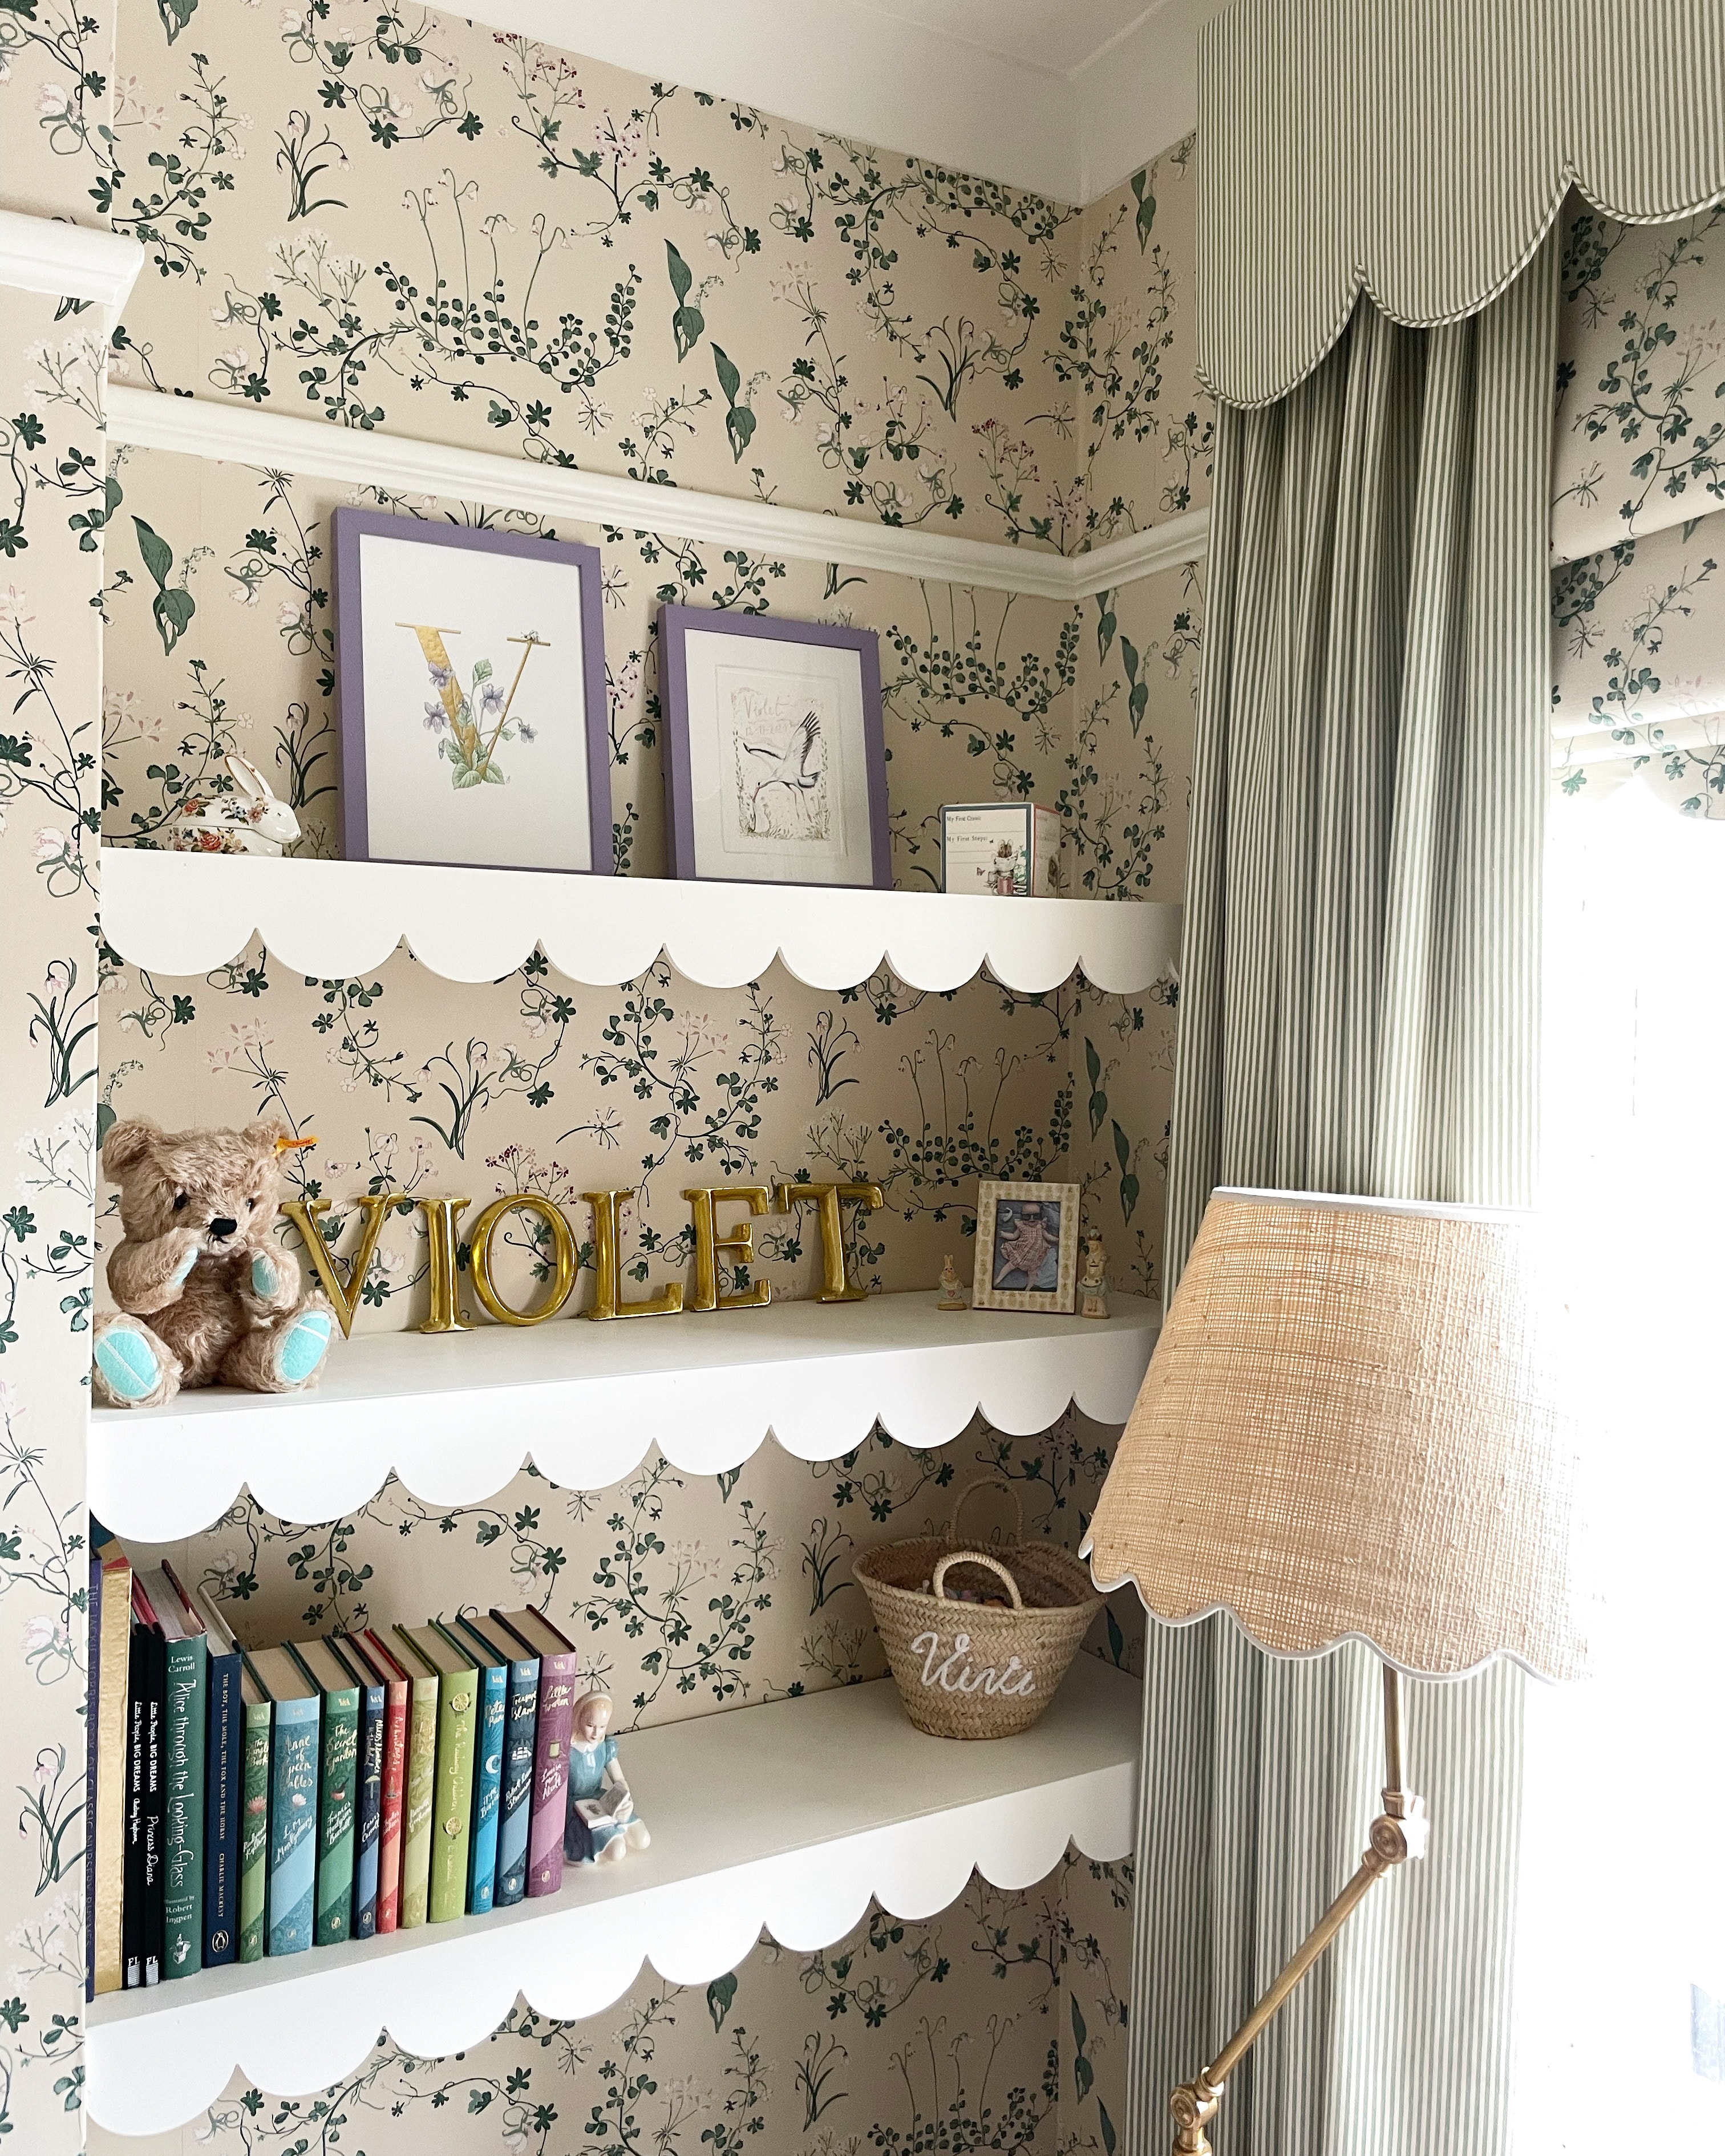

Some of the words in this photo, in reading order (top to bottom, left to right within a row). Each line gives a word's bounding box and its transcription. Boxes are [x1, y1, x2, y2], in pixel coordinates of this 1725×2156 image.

[280, 1182, 884, 1340] VIOLET
[168, 1662, 195, 1672] Carroll
[171, 1655, 193, 1664] Lewis
[168, 1679, 197, 1713] Alice
[543, 1684, 572, 1703] Little
[332, 1723, 350, 1737] The
[168, 1716, 189, 1768] through
[285, 1735, 311, 1755] Anne
[326, 1729, 358, 1753] Secret
[295, 1747, 305, 1762] of
[169, 1770, 189, 1791] the
[147, 1815, 159, 1852] Princess
[167, 1793, 195, 1888] Looking-Glass
[146, 1853, 159, 1886] Diana
[165, 1904, 192, 1914] Robert
[166, 1913, 192, 1924] Ingpen
